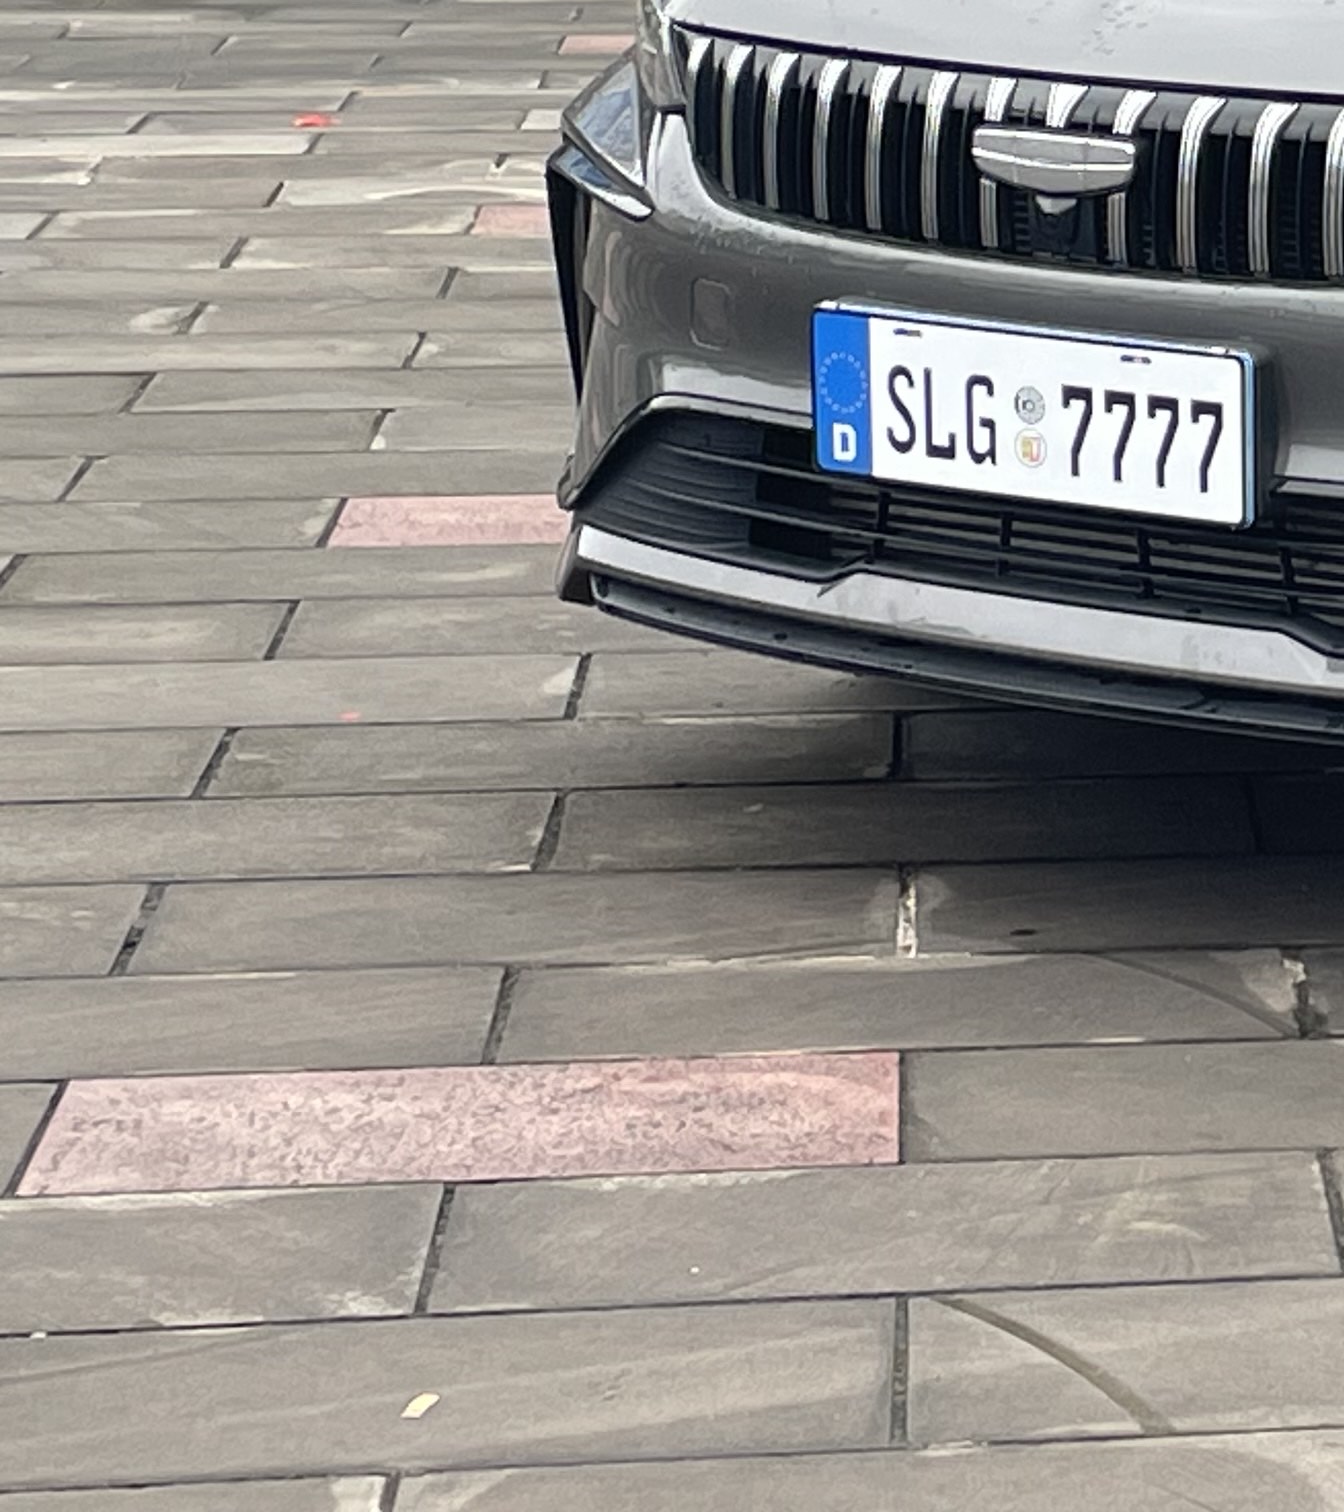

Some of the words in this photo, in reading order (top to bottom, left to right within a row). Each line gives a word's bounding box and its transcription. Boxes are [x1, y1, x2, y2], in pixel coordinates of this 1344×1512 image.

[832, 423, 857, 462] D
[887, 365, 997, 467] SLG
[1062, 384, 1223, 493] 7777
